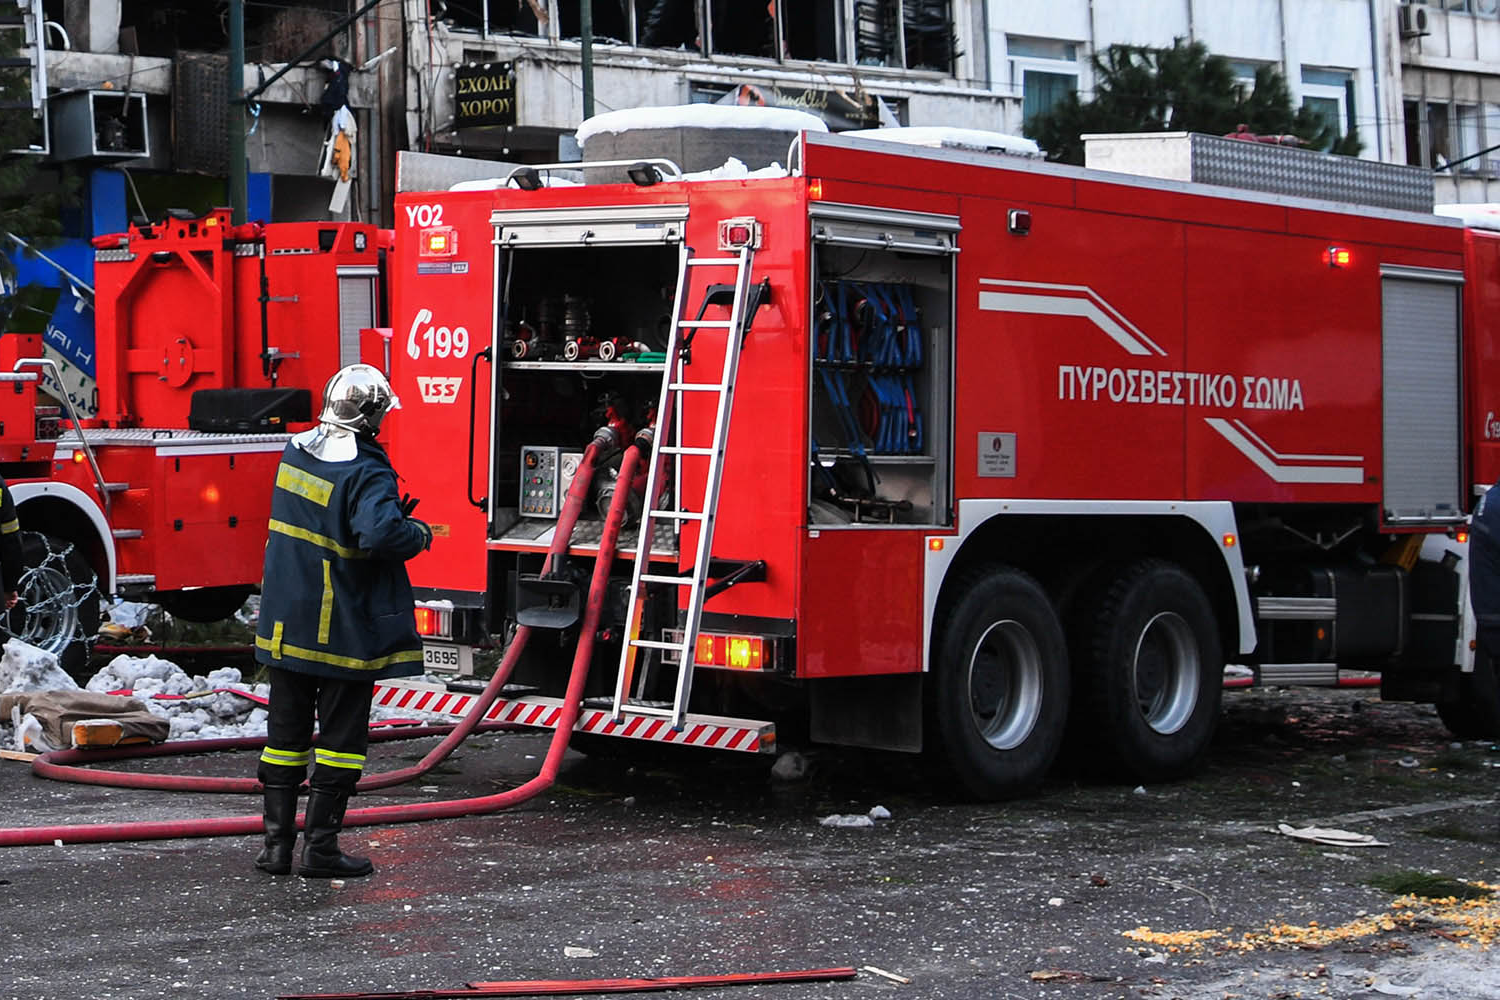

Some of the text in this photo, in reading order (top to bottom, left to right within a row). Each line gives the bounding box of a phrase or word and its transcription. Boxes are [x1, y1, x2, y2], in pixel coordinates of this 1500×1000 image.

[458, 75, 510, 94] ΣΧΟΛΗ
[460, 98, 513, 117] ΧΟΡΟΥ
[423, 326, 469, 358] 199
[424, 383, 455, 397] ISS
[1058, 365, 1305, 411] ΠΥΡΟΣΒΕΣΤΙΚΟ ΣΩΜΑ
[425, 650, 458, 665] 3695
